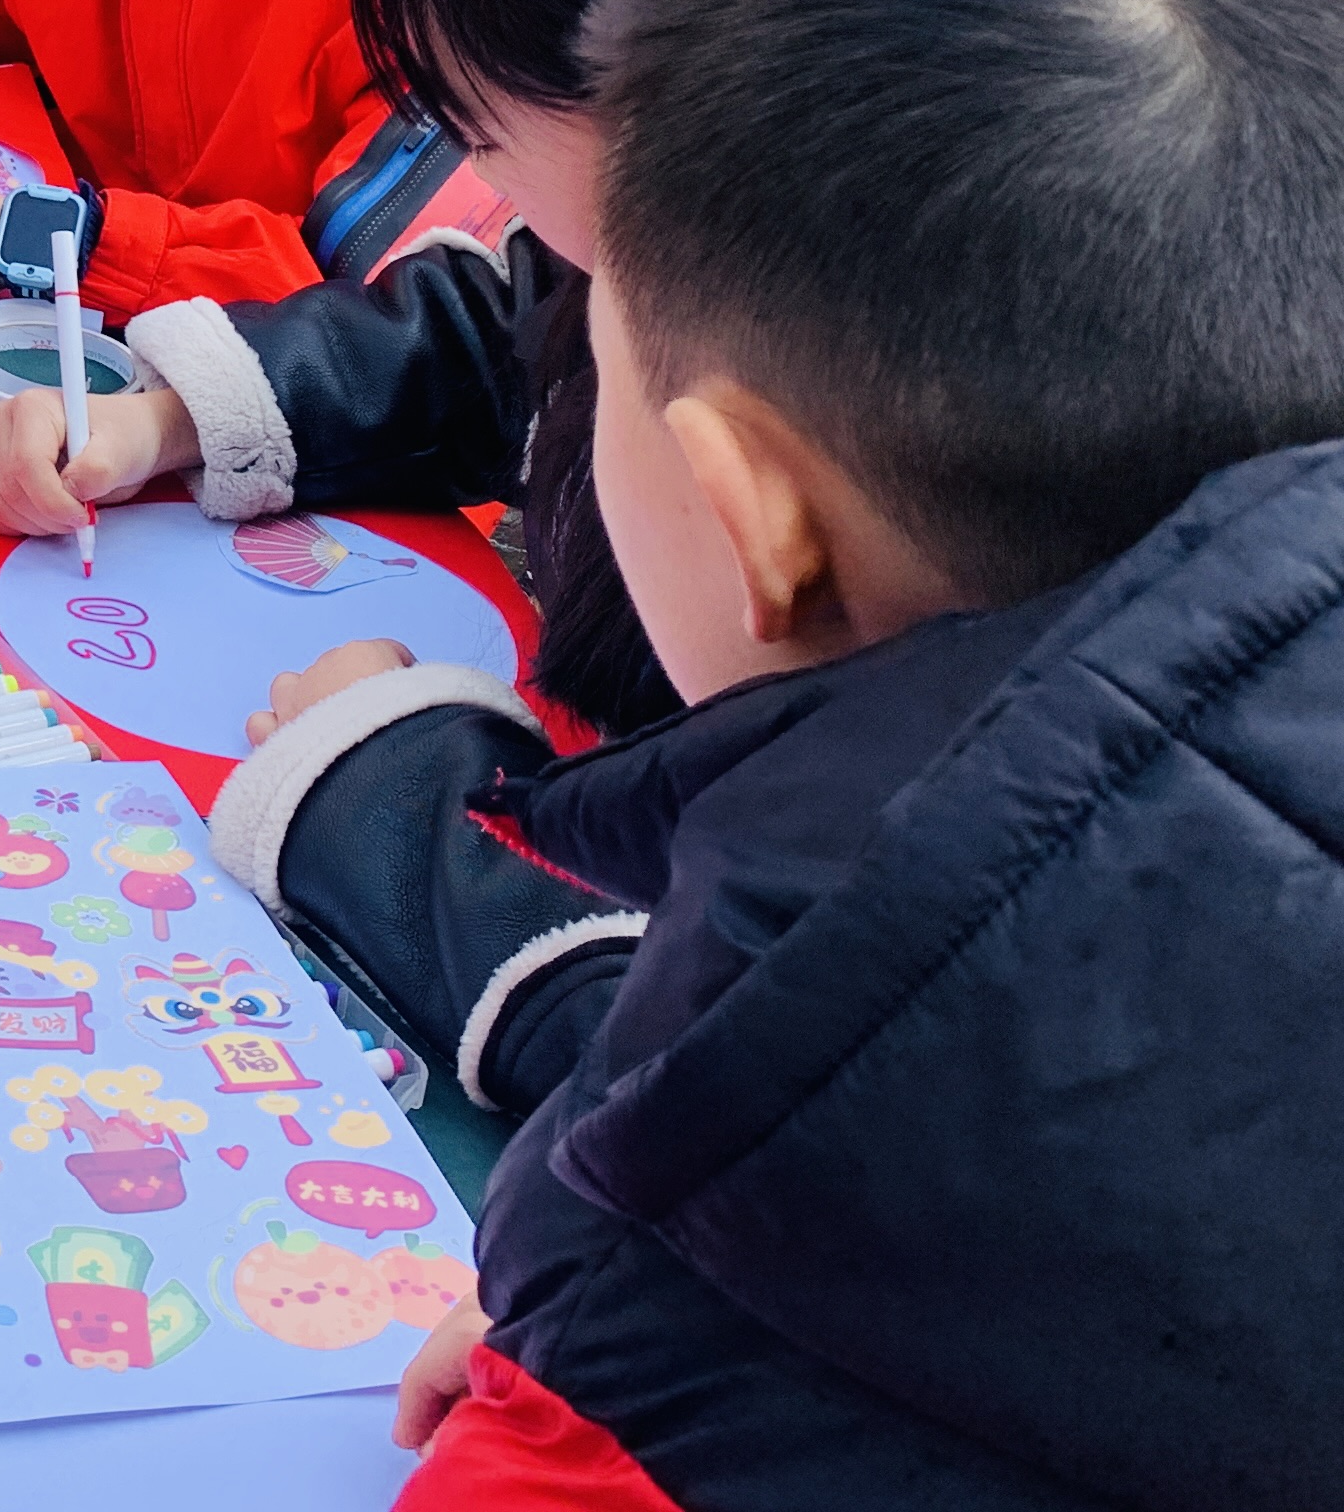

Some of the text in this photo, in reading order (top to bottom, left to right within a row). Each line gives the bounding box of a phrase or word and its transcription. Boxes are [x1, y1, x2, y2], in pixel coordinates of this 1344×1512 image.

[221, 1037, 280, 1080] 福
[297, 1177, 422, 1213] 大吉大利
